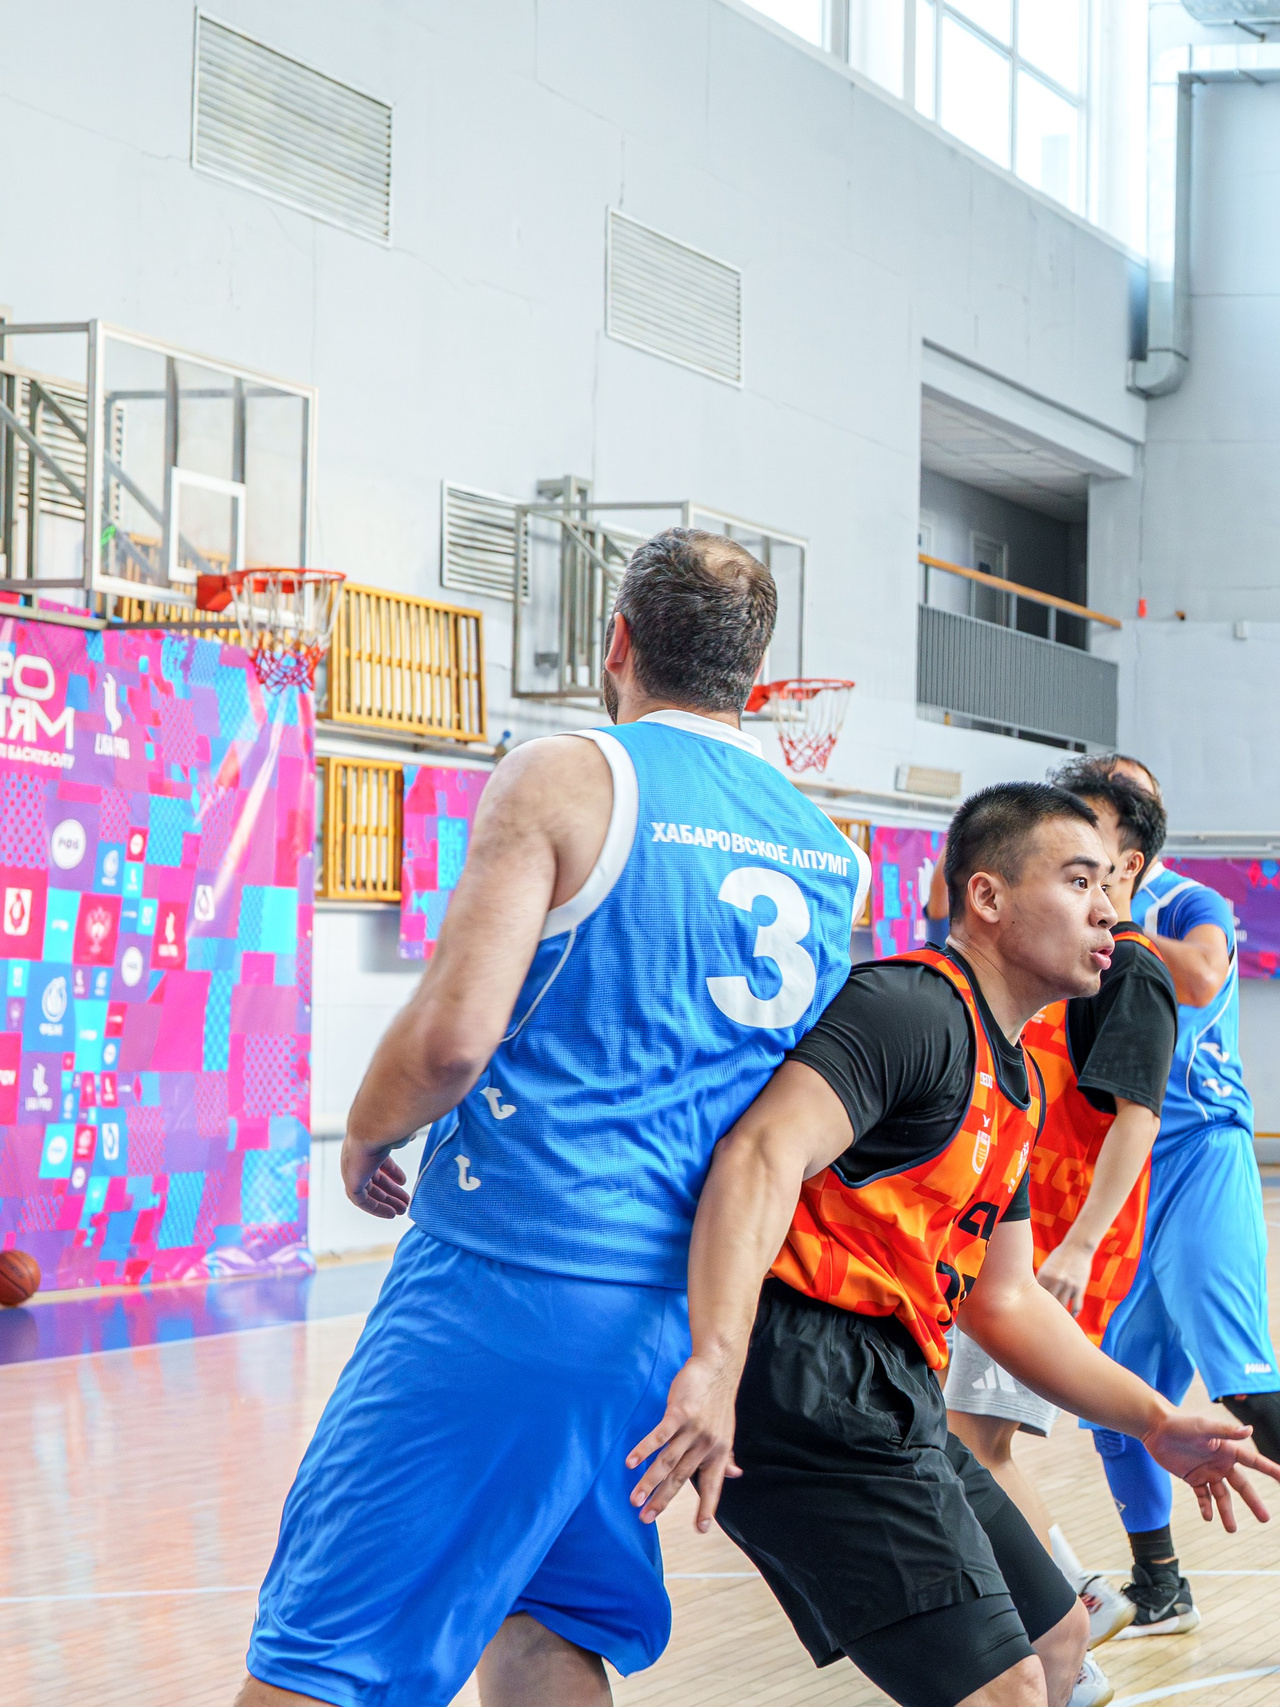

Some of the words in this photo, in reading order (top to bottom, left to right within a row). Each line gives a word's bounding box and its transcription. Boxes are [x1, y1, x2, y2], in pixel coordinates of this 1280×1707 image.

[651, 821, 790, 866] ХАБАРОВСКОЕ
[792, 848, 851, 877] ЛПУМГ
[706, 867, 816, 1029] 3
